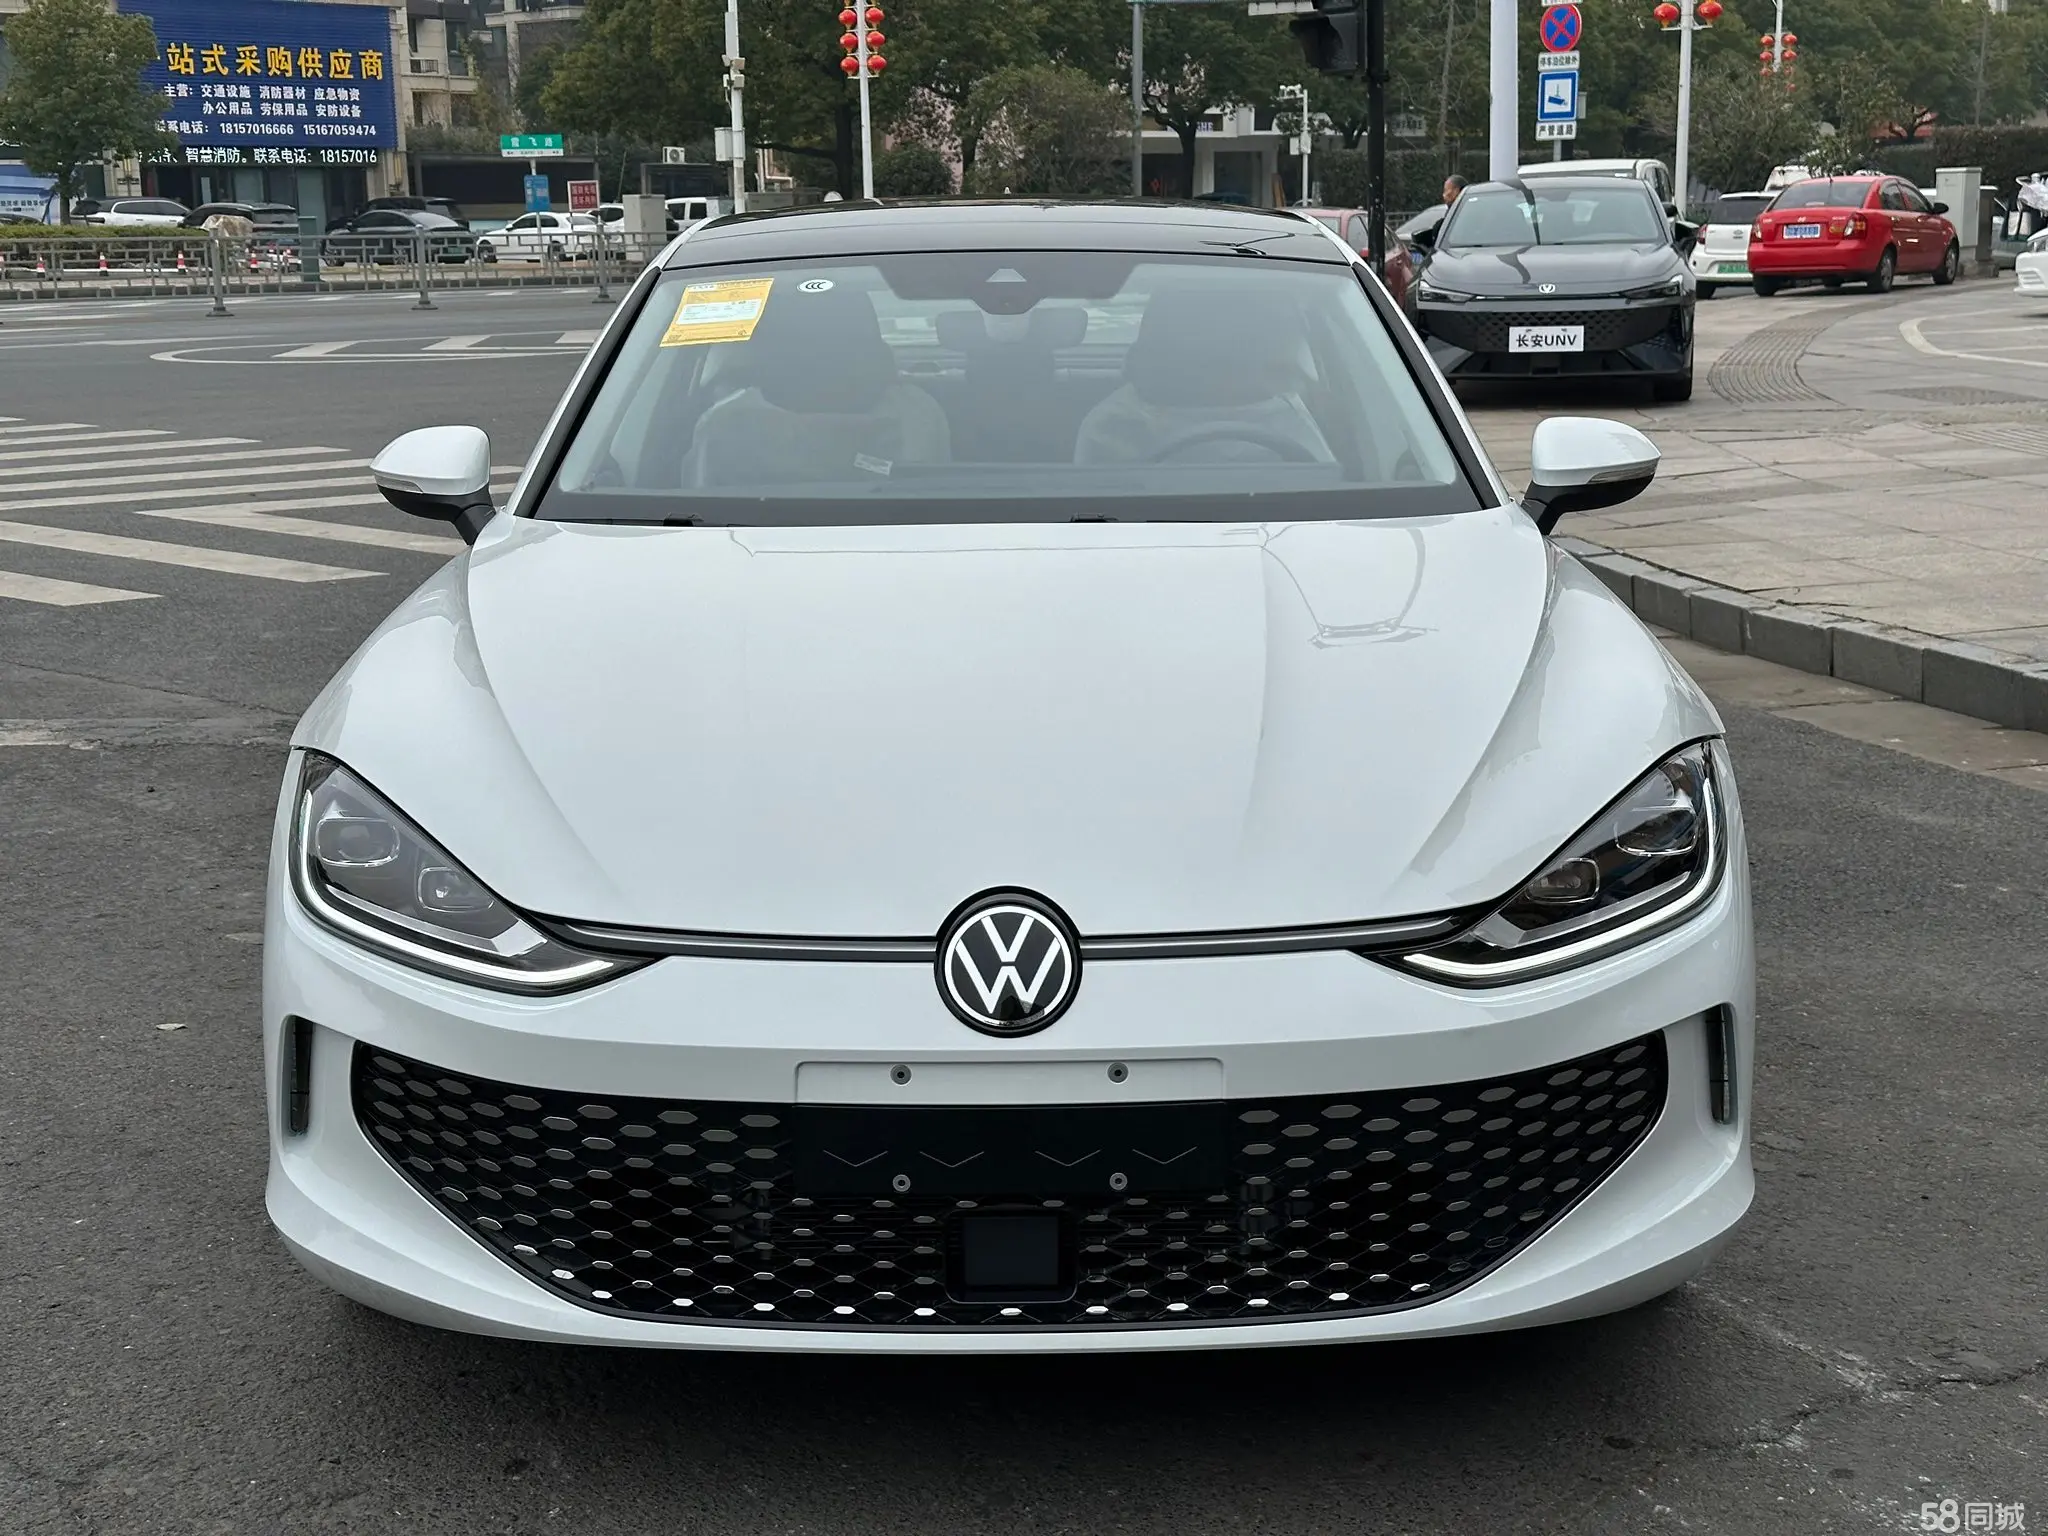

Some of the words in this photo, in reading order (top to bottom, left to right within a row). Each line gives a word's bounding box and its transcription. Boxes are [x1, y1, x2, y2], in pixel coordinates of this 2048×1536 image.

[157, 42, 384, 80] 站式采购供应商
[163, 83, 193, 98] 主营：
[201, 84, 251, 99] 交通设施
[259, 85, 307, 100] 消防器材
[314, 87, 361, 101] 应急物资
[202, 101, 253, 116] 办公用品
[260, 102, 308, 117] 劳保用品
[315, 103, 361, 118] 安防设备
[219, 122, 294, 135] 18157016666
[303, 123, 377, 136] 15167059474
[805, 281, 827, 291] CCC
[1516, 334, 1577, 348] 长安UNV
